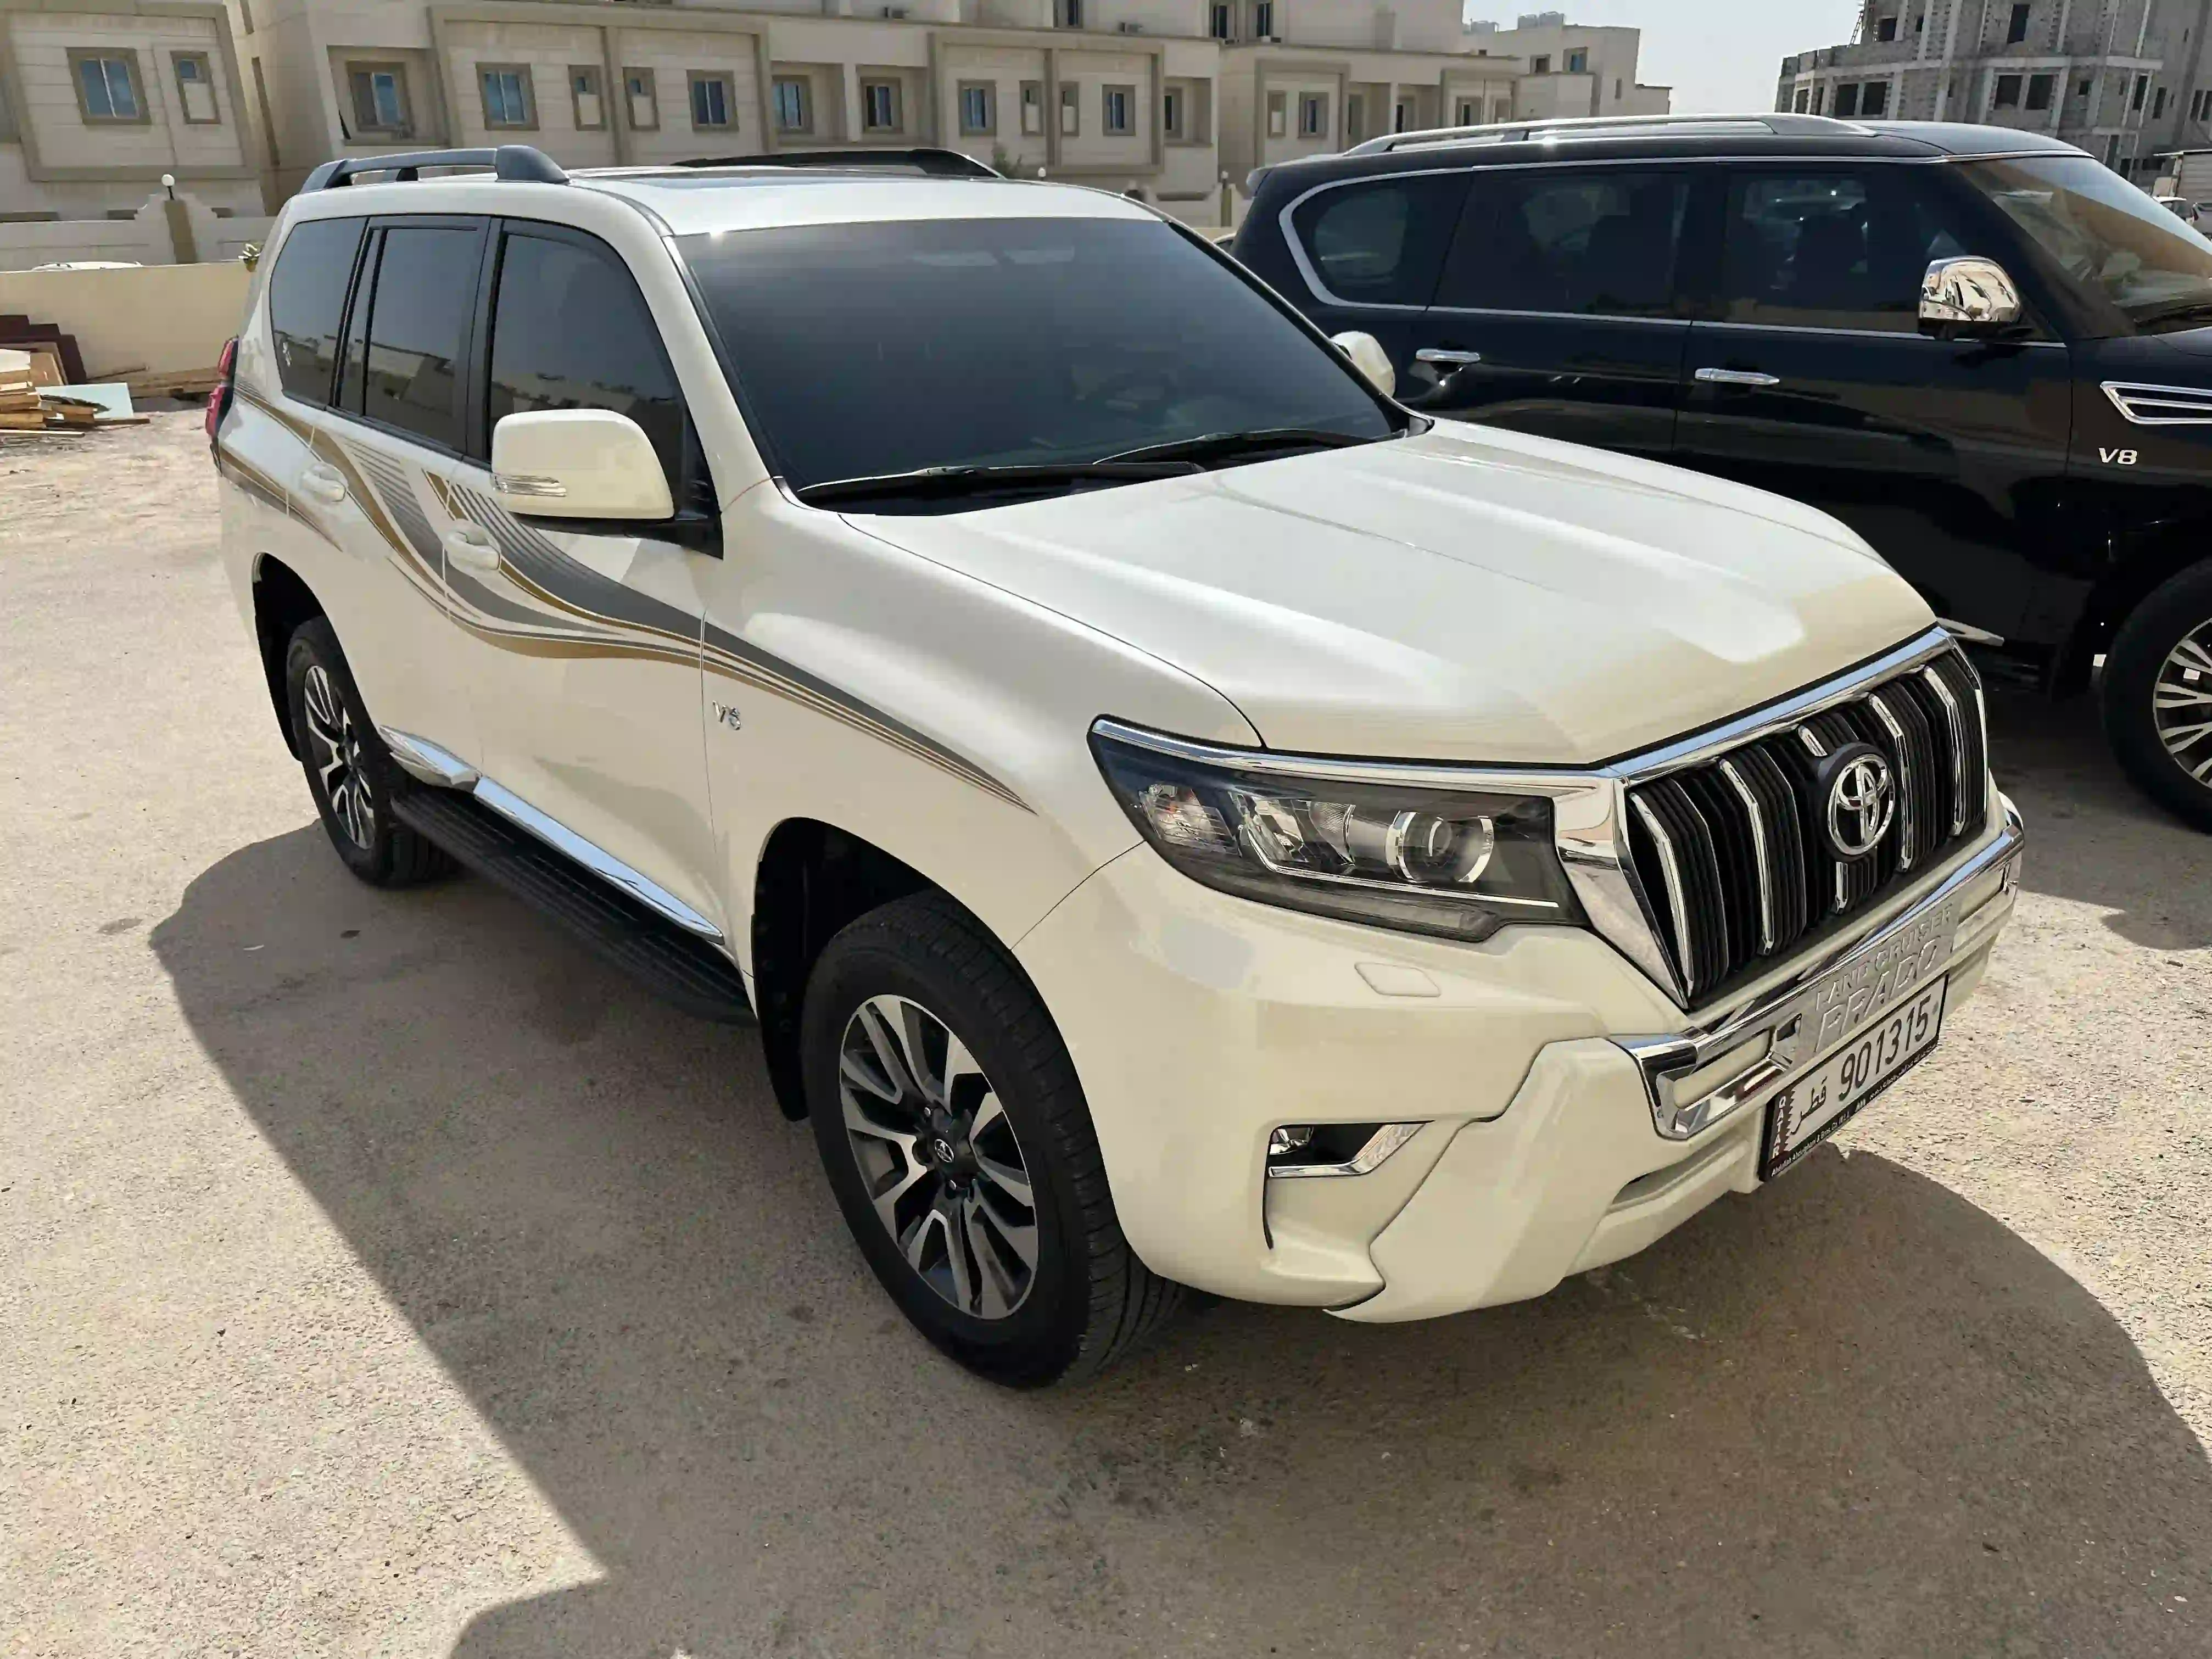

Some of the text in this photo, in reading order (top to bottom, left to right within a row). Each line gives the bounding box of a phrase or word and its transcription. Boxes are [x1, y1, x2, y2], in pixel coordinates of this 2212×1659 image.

[2098, 447, 2138, 465] V8
[712, 700, 741, 730] V6
[1816, 903, 1952, 1011] LAND CRUISER
[1814, 935, 1941, 1052] PRADO
[1839, 993, 1931, 1102] 901315
[1772, 1096, 1786, 1159] QATAR
[1790, 1076, 1827, 1135] قطر
